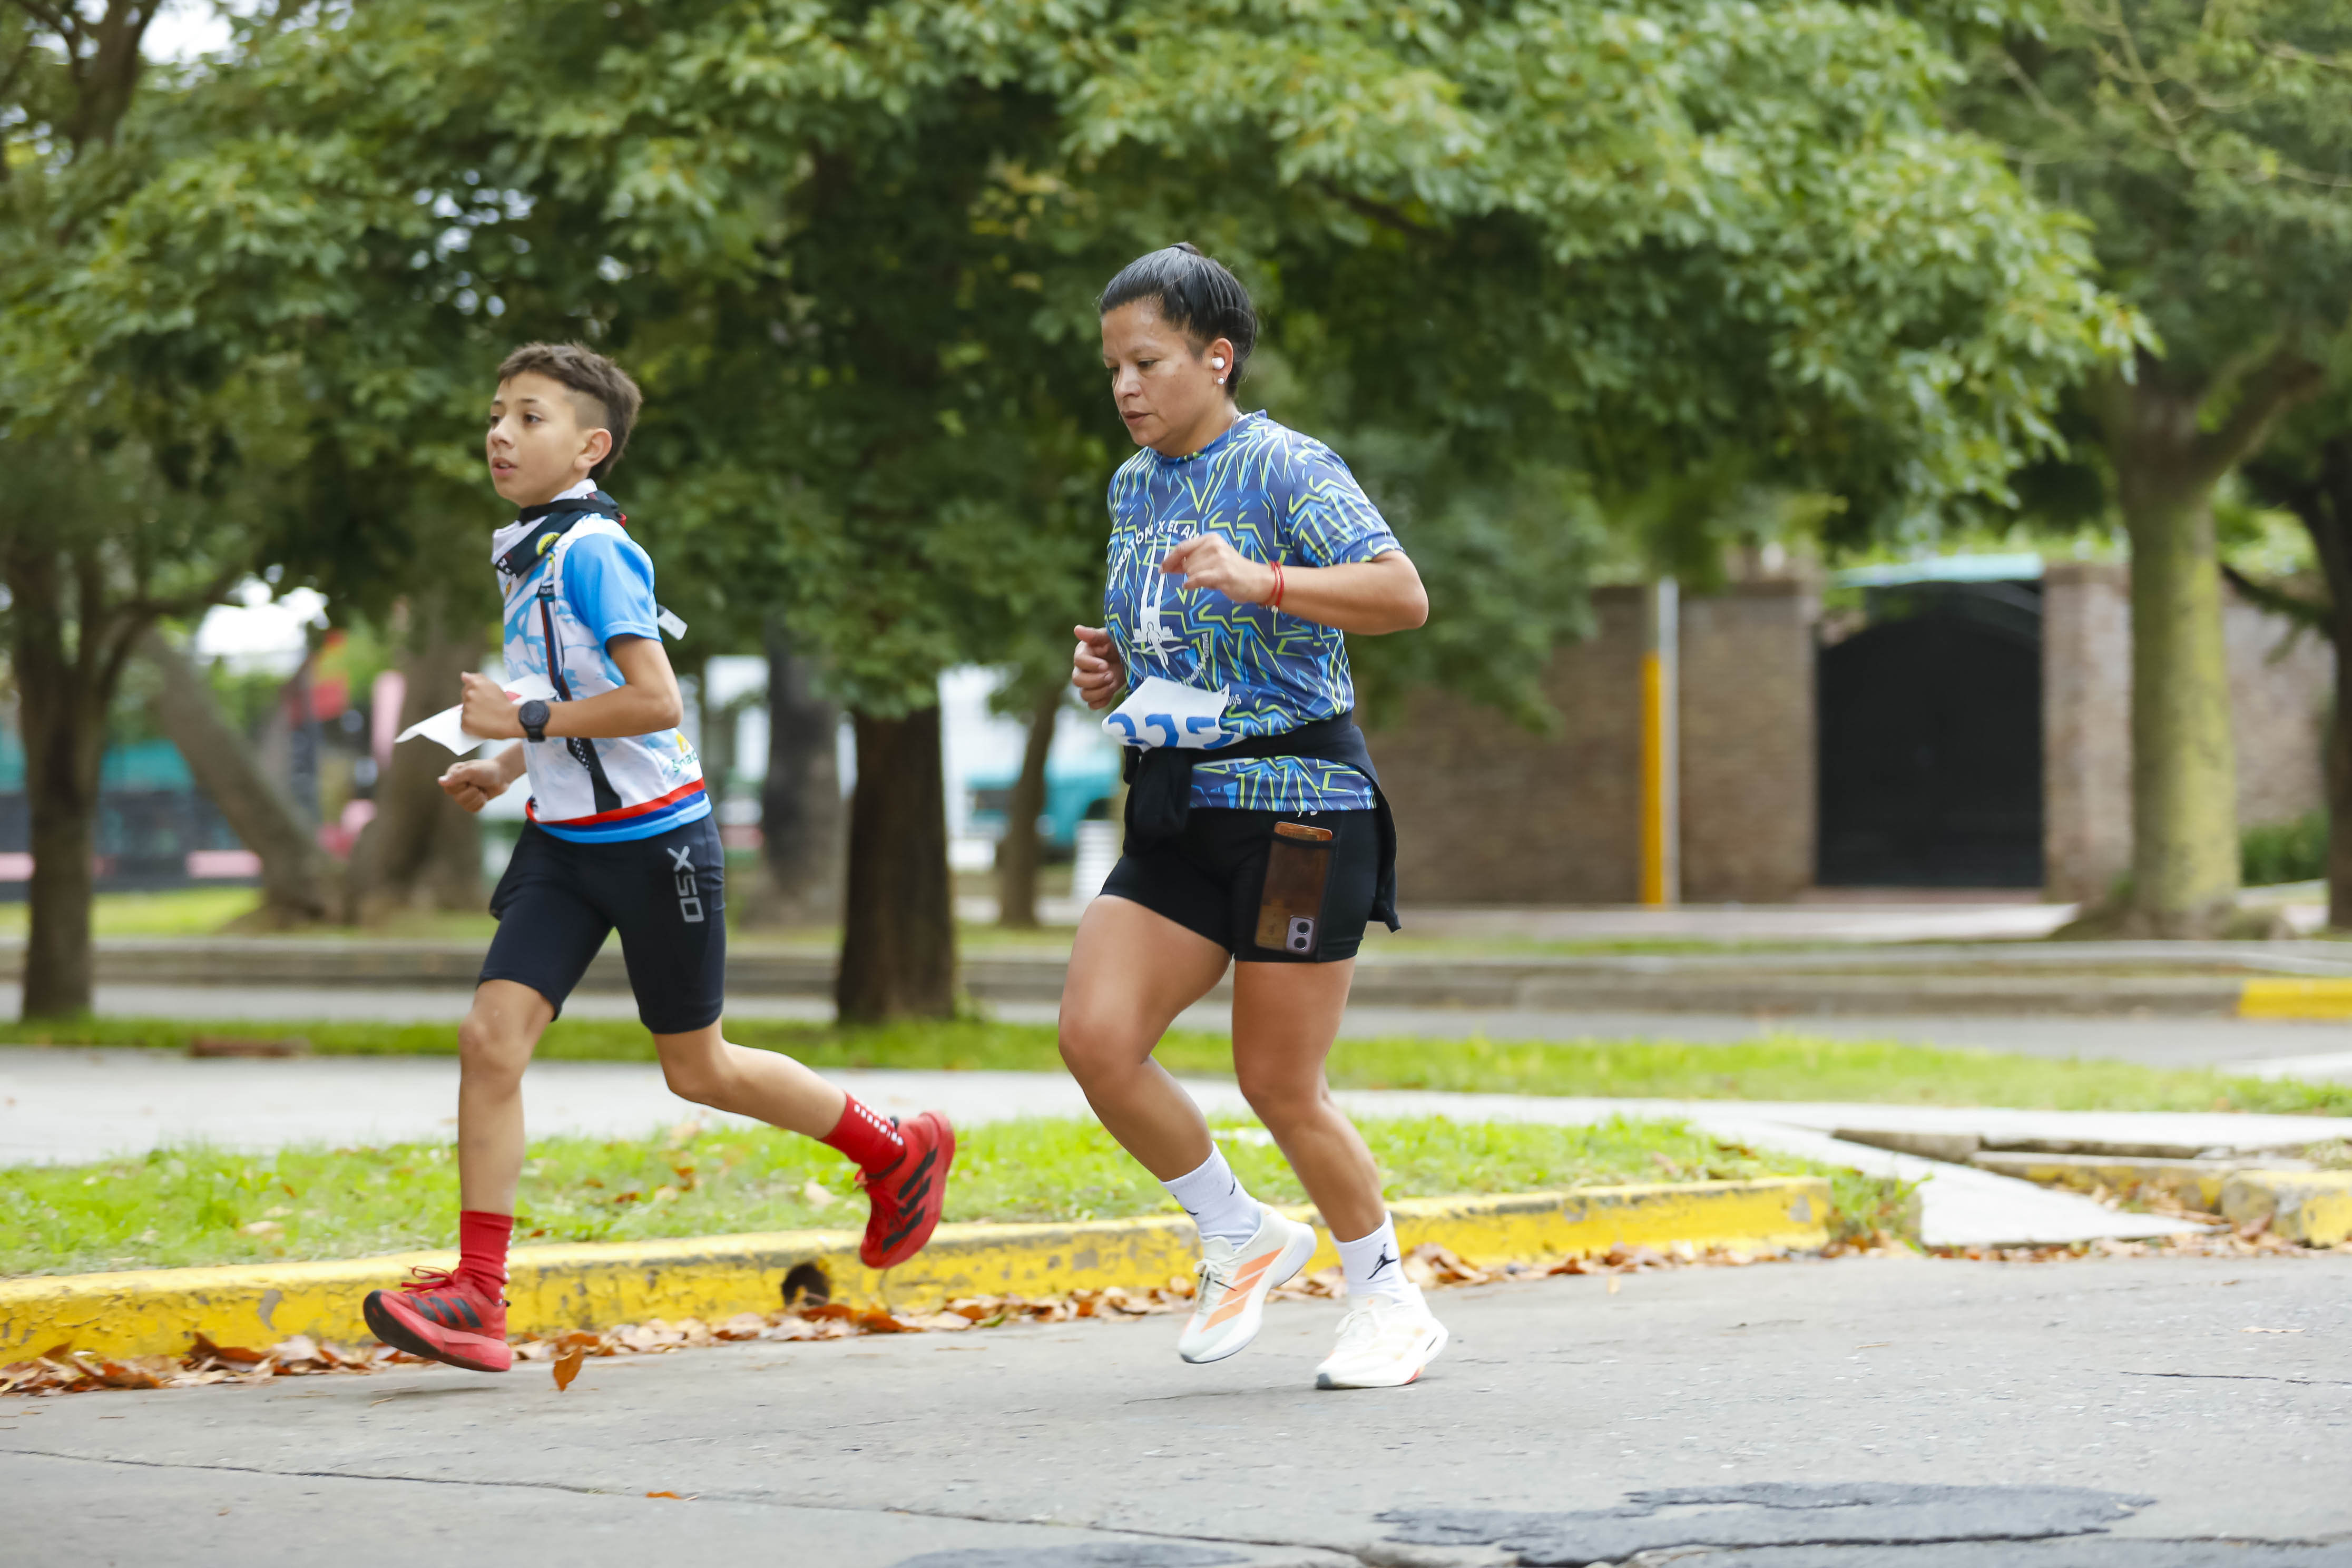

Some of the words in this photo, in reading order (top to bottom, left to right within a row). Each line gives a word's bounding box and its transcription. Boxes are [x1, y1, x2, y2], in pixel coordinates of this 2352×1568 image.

[1157, 520, 1166, 534] X
[1167, 519, 1180, 534] EL
[1227, 693, 1242, 706] DOS
